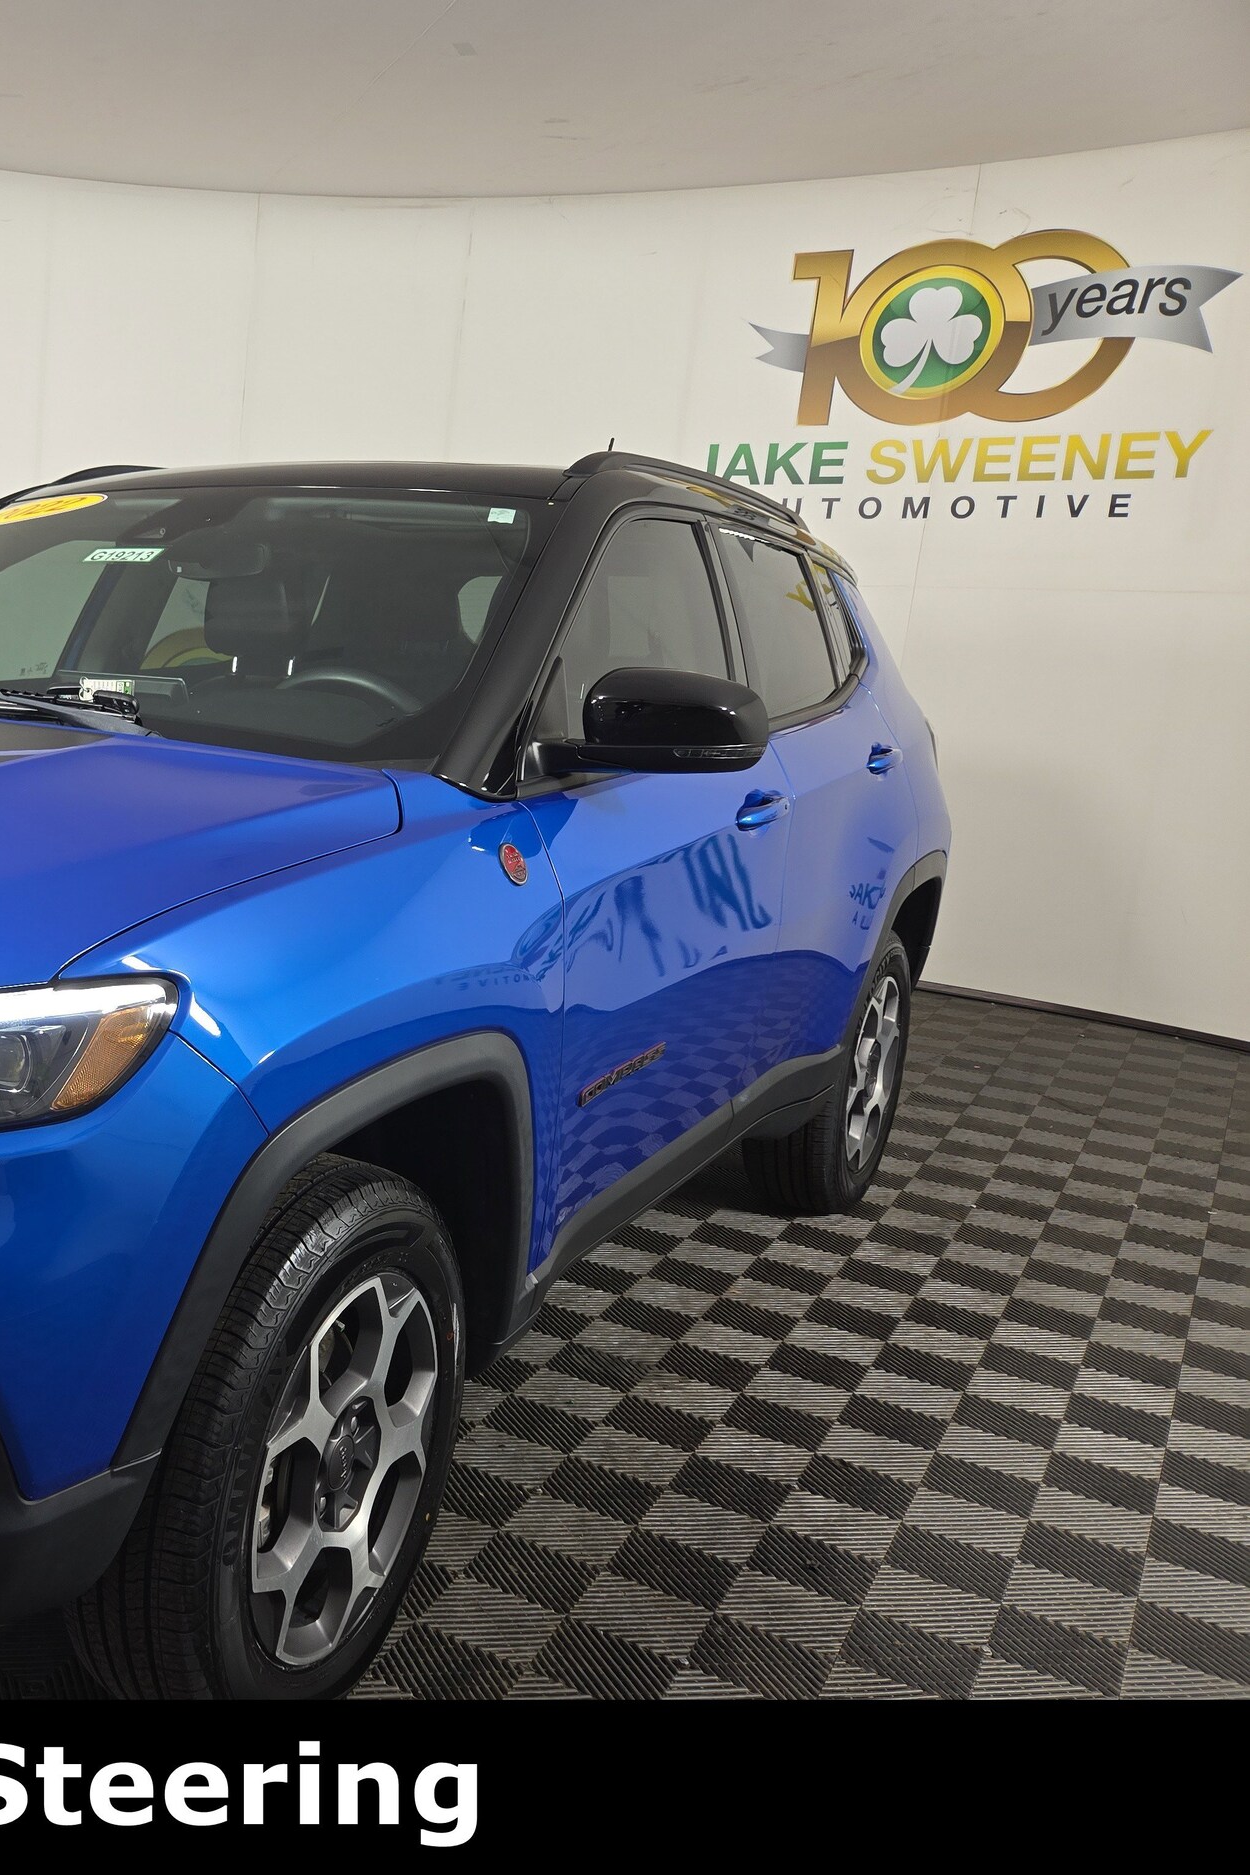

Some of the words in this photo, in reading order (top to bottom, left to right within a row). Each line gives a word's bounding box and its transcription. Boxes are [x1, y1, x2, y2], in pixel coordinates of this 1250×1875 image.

[1041, 275, 1193, 337] years
[866, 428, 1214, 485] SWEENEY
[782, 493, 1133, 520] TOMOTIVE
[90, 550, 155, 562] G19213
